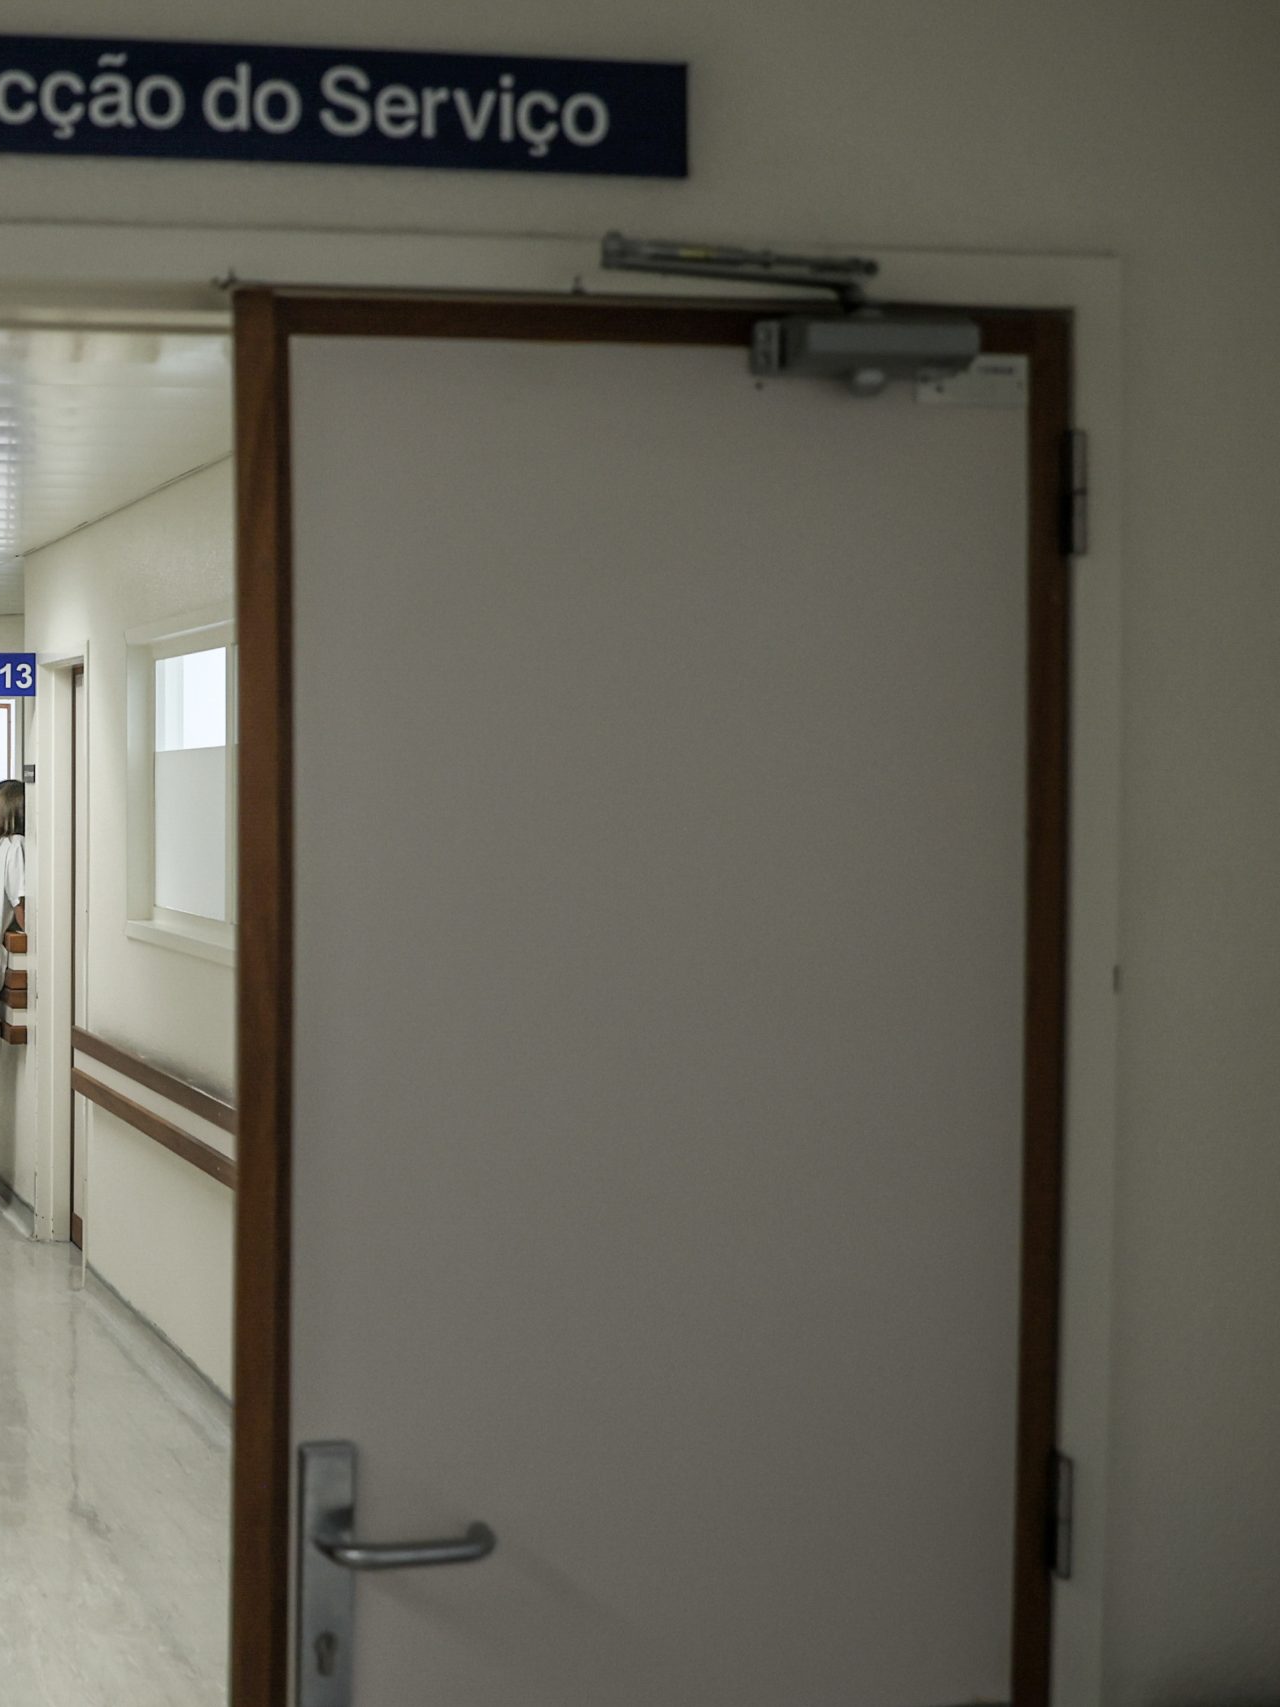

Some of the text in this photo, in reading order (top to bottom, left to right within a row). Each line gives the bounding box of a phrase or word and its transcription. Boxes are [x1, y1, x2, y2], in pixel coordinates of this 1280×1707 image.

[202, 62, 302, 133] do
[319, 65, 610, 156] Serviço
[0, 663, 33, 689] 13
